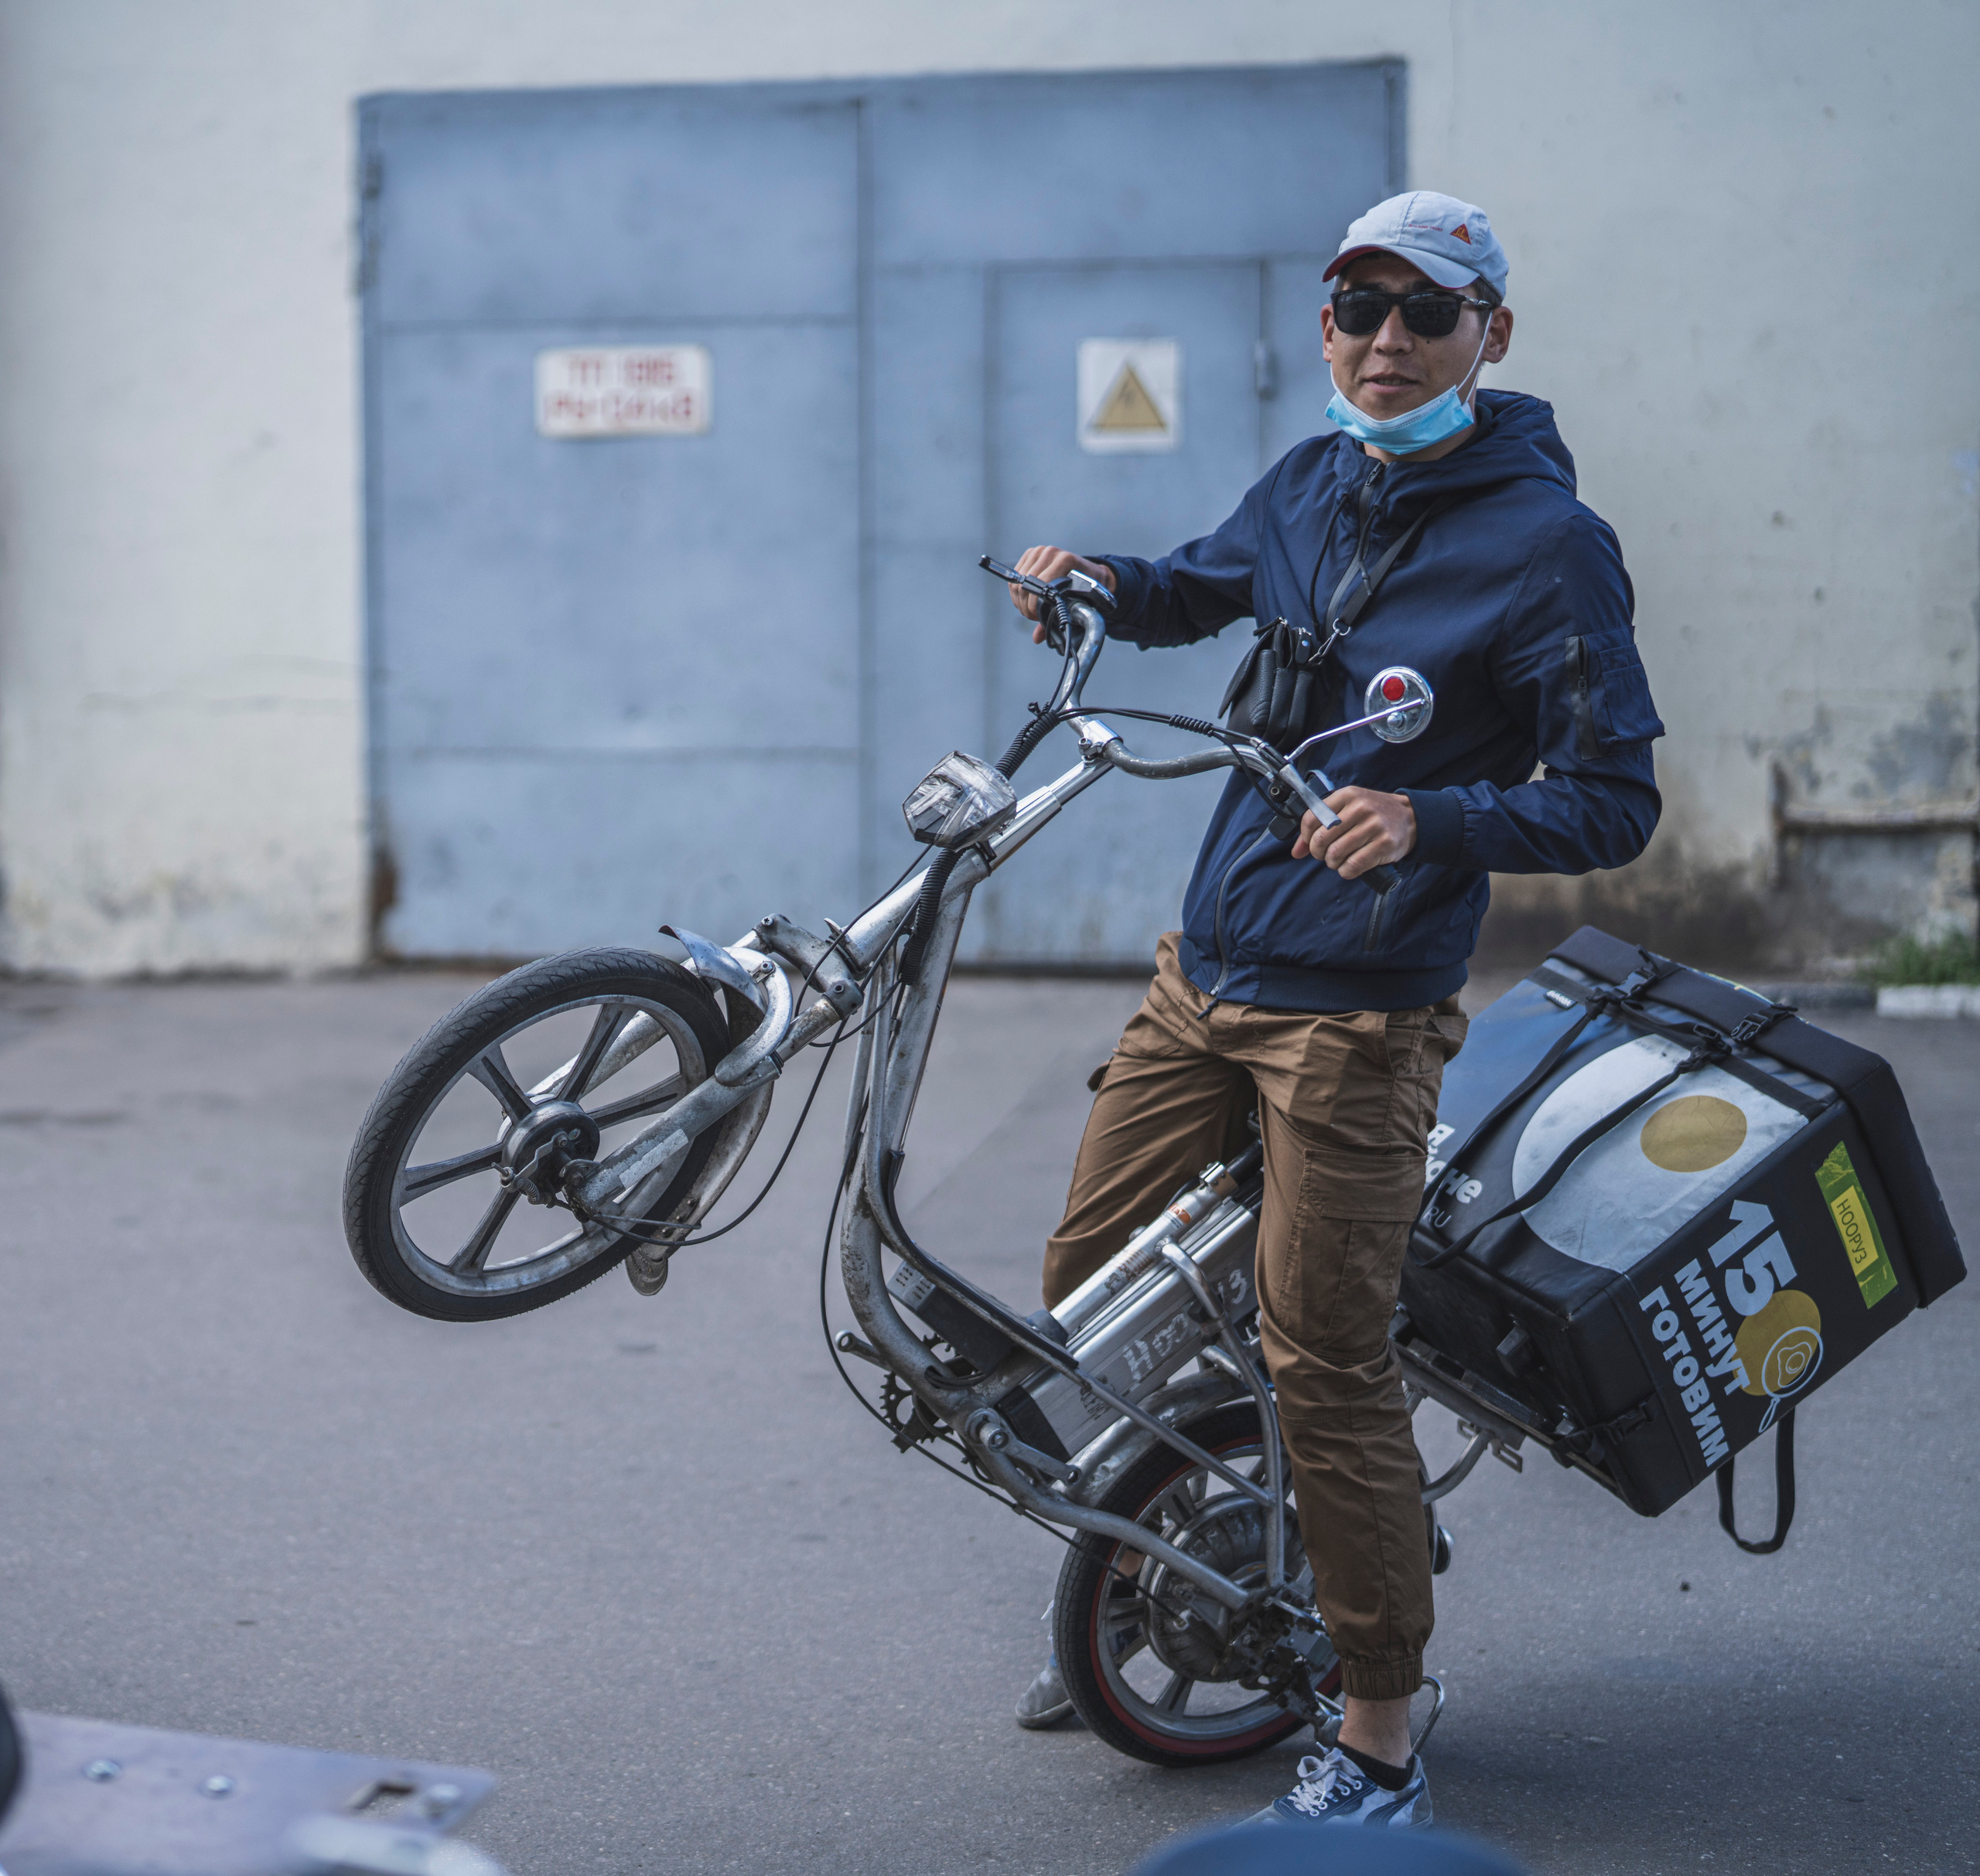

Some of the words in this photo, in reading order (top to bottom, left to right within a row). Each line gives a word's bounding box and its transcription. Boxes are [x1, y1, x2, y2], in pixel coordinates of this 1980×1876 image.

[1453, 227, 1469, 242] Sika
[1708, 1199, 1797, 1316] 15
[1836, 1199, 1867, 1264] НООРУЗ
[1639, 1285, 1729, 1468] ГОТОВИМ
[1674, 1258, 1750, 1396] МИНУТ
